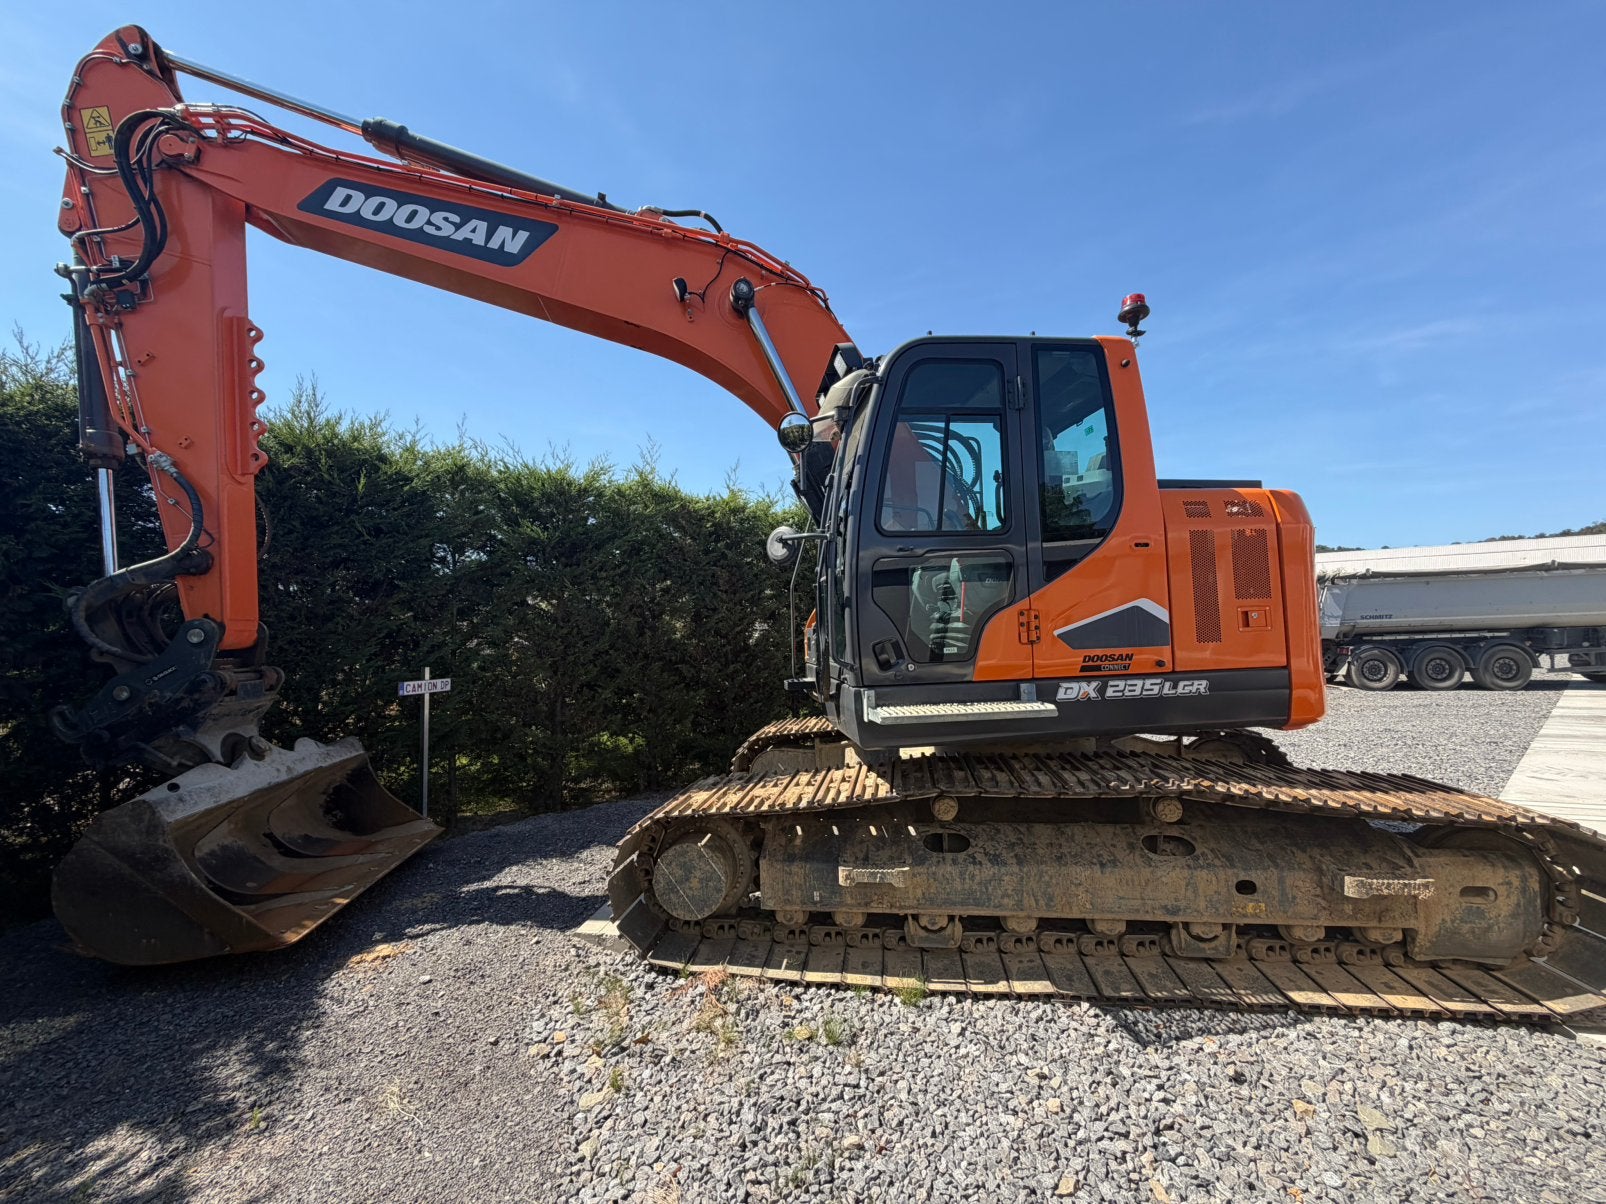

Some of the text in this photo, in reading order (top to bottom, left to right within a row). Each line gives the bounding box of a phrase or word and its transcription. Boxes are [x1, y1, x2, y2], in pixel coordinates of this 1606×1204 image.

[323, 186, 531, 254] DOOSAN
[1082, 653, 1134, 664] DOOSAN
[1100, 663, 1130, 672] CONNECT
[405, 681, 449, 693] CAMION DP
[1056, 680, 1101, 702] DX
